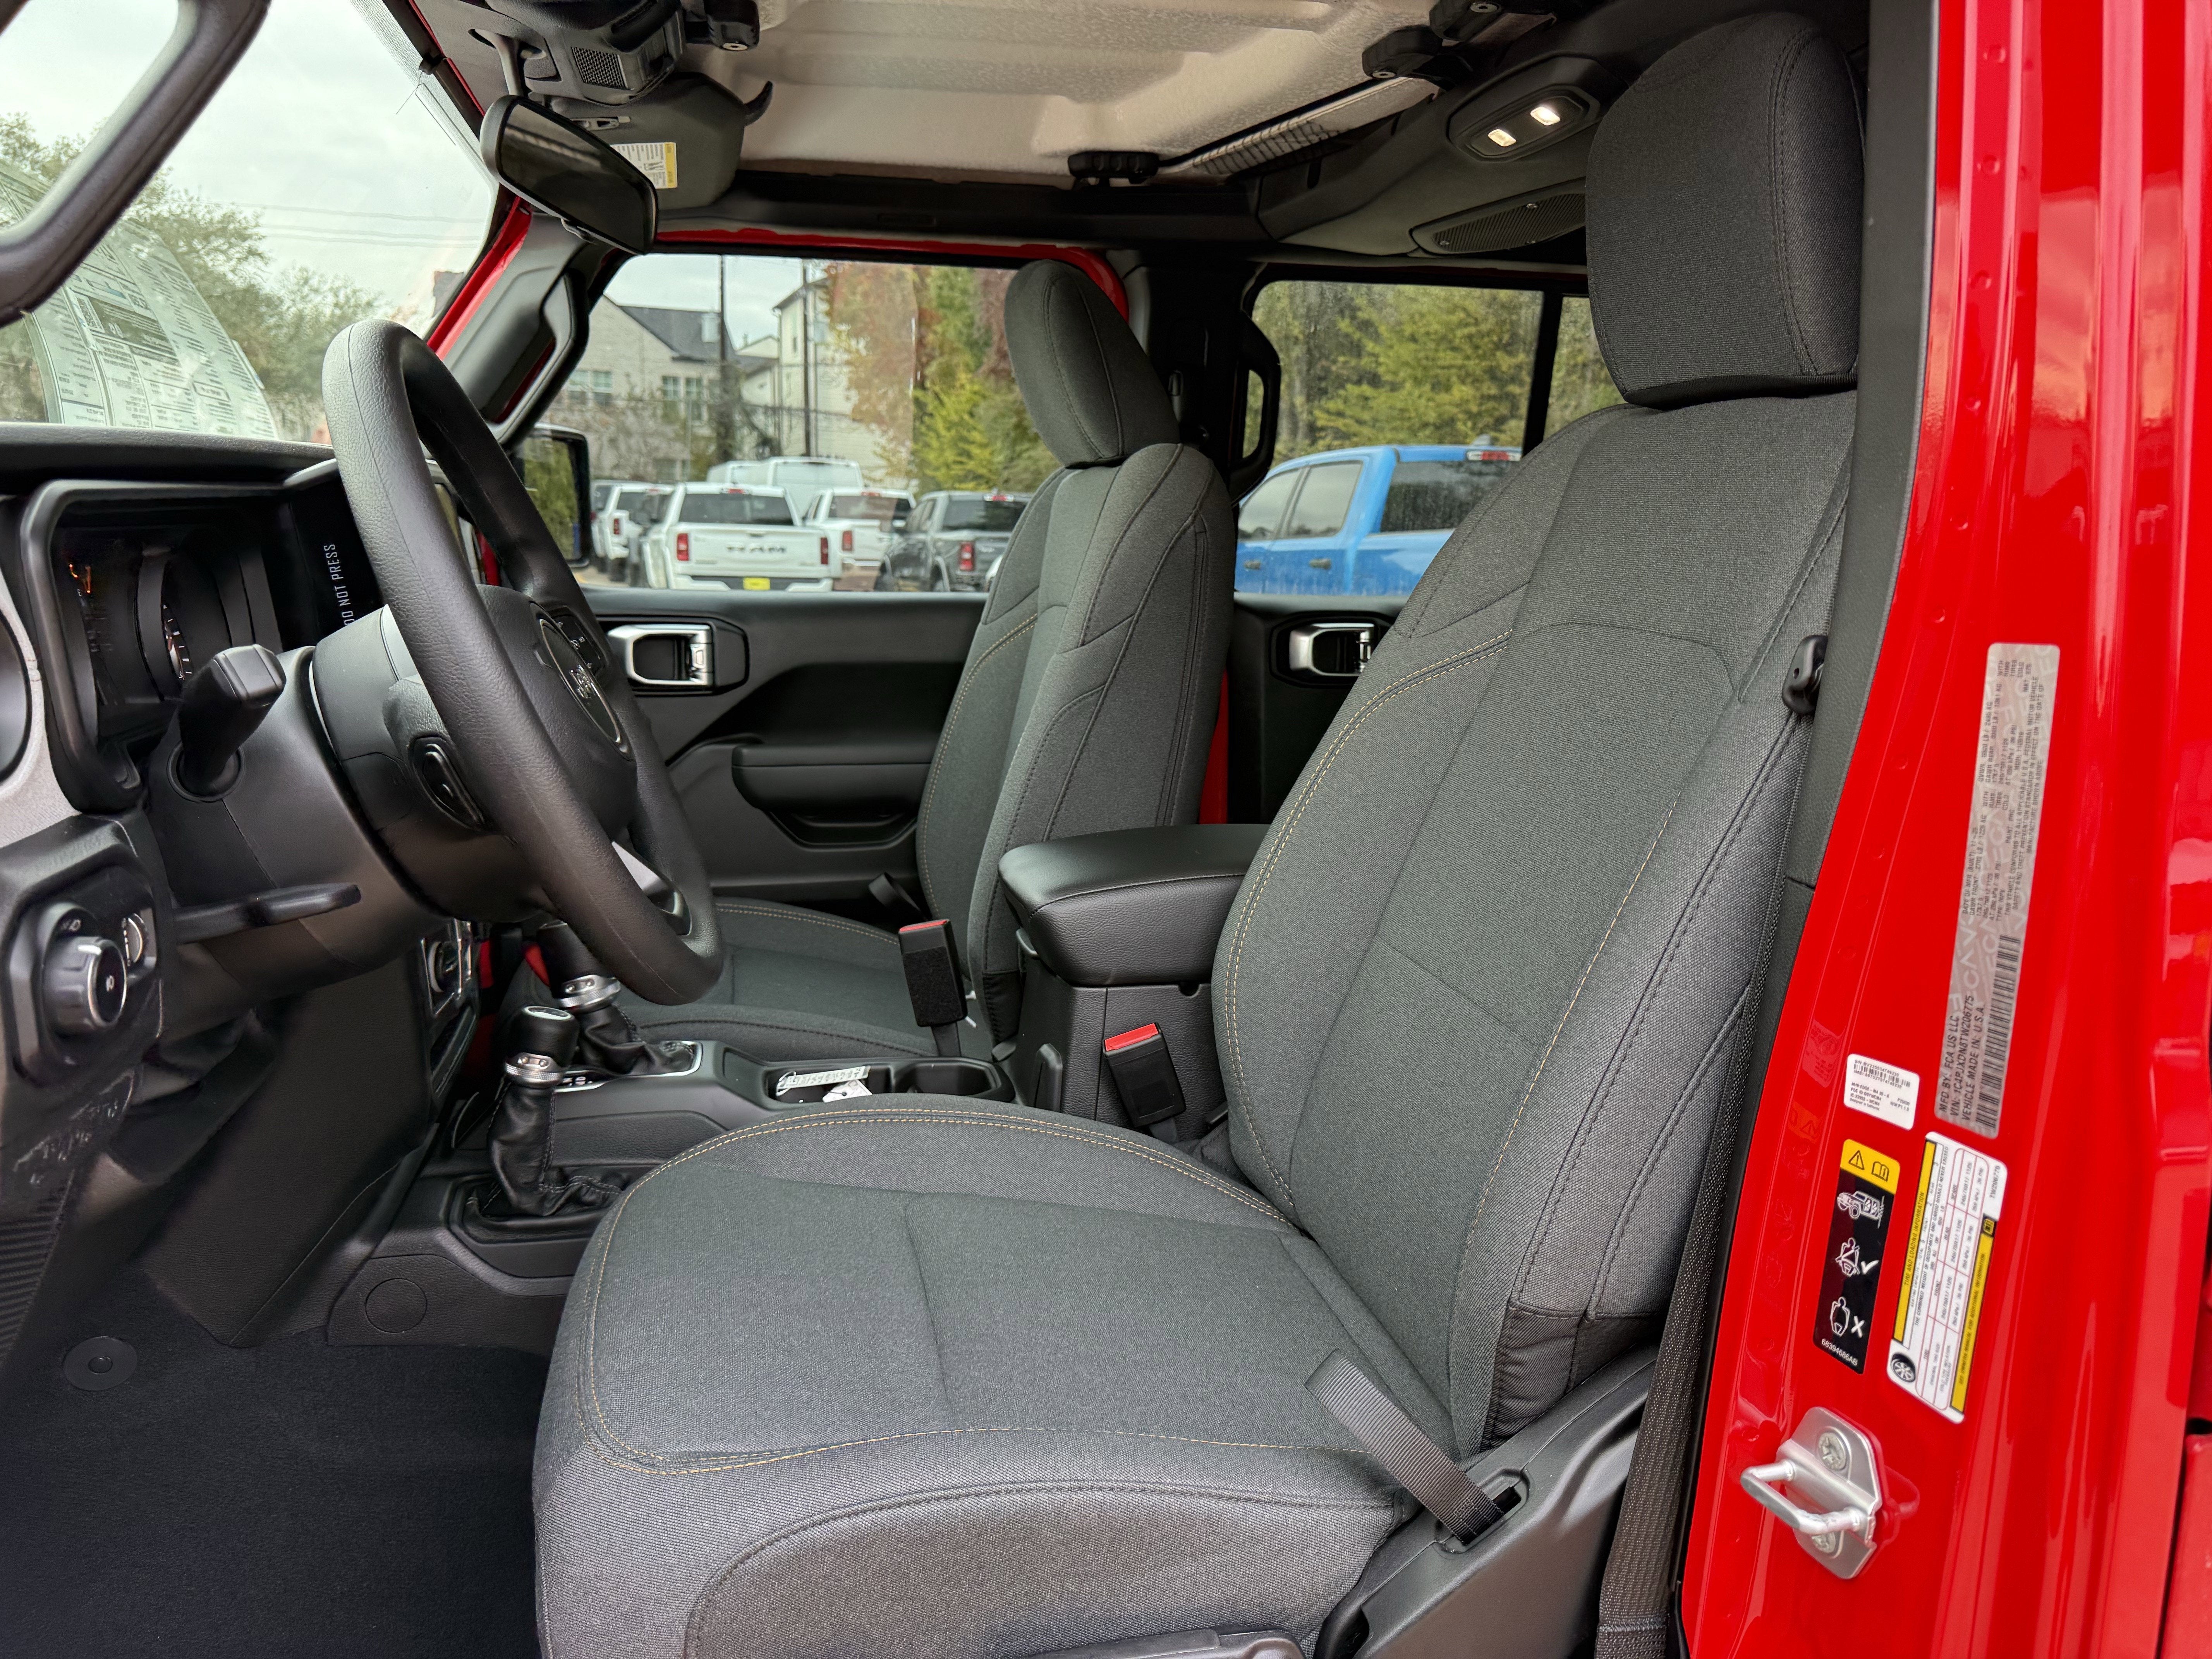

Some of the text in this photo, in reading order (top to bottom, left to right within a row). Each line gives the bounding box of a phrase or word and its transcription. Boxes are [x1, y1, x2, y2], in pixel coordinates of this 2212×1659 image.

[323, 544, 355, 626] DO NOT PRESS
[2030, 677, 2039, 701] VEHICLE
[1986, 702, 1993, 710] KG
[2027, 704, 2036, 725] MOTOR
[2023, 729, 2033, 756] FEDERAL
[2033, 726, 2040, 735] ON
[2030, 739, 2039, 760] EFFECT
[2016, 778, 2027, 816] APPLICABLE
[2025, 770, 2035, 808] STANDARDS
[1980, 814, 1986, 823] KG
[2026, 759, 2043, 854] MANUFACTURE SHOWN ABOVE
[2013, 830, 2020, 838] TO
[2020, 810, 2030, 848] PREVENTION
[2009, 840, 2019, 874] CONFORMS
[1964, 888, 1971, 896] OF
[2006, 876, 2015, 900] VEHICLE
[1989, 912, 1995, 920] AT
[1948, 1015, 1959, 1032] LLC
[1946, 1034, 1957, 1048] US
[1944, 1050, 1955, 1069] FCA
[1950, 994, 1974, 1118] VIN: 1C4PJXDN8TW206775
[1966, 1051, 1979, 1080] MADE
[1939, 1091, 1950, 1113] MFD
[1962, 1082, 1975, 1121] VEHICLE
[1908, 1231, 1917, 1258] LOADING
[1913, 1191, 1924, 1231] INFORMATION
[1916, 1290, 1924, 1316] COMBINED
[1925, 1233, 1934, 1262] OCCUPANTS
[1964, 1331, 1972, 1353] MANUAL
[1970, 1289, 1979, 1319] ADDITIONAL
[1975, 1252, 1985, 1289] INFORMATION
